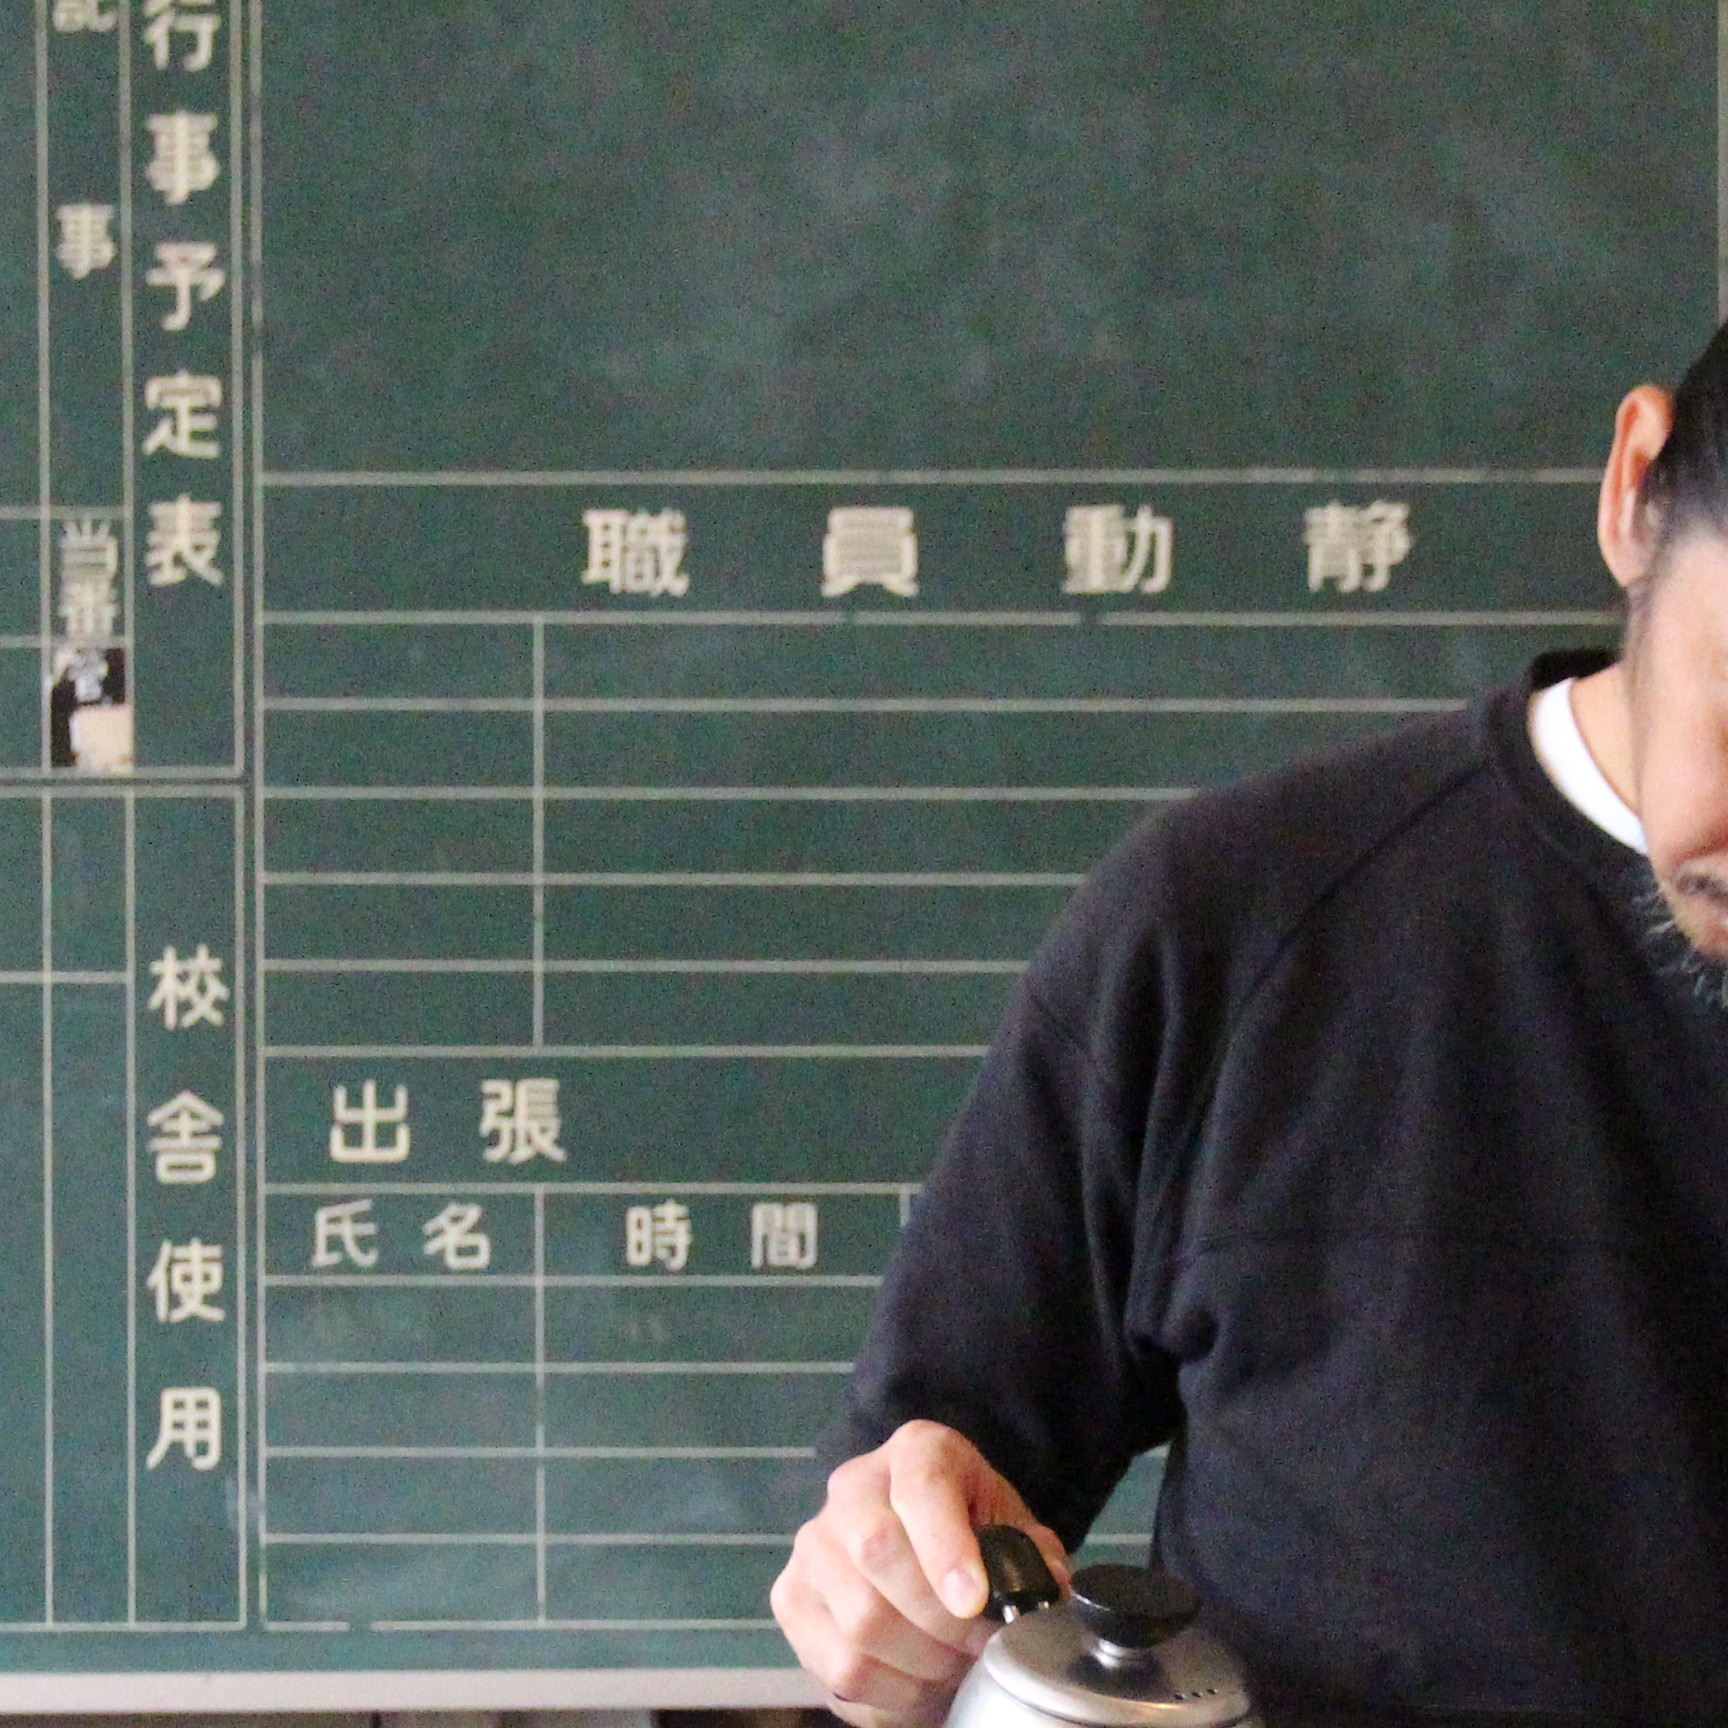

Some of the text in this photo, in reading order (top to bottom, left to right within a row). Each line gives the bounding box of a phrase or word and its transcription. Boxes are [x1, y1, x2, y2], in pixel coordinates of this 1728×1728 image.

[581, 500, 1412, 599] 職員動静
[328, 1078, 568, 1165] 出張
[145, 945, 229, 1472] 校舎使用
[310, 1200, 819, 1271] 氏名 時間
